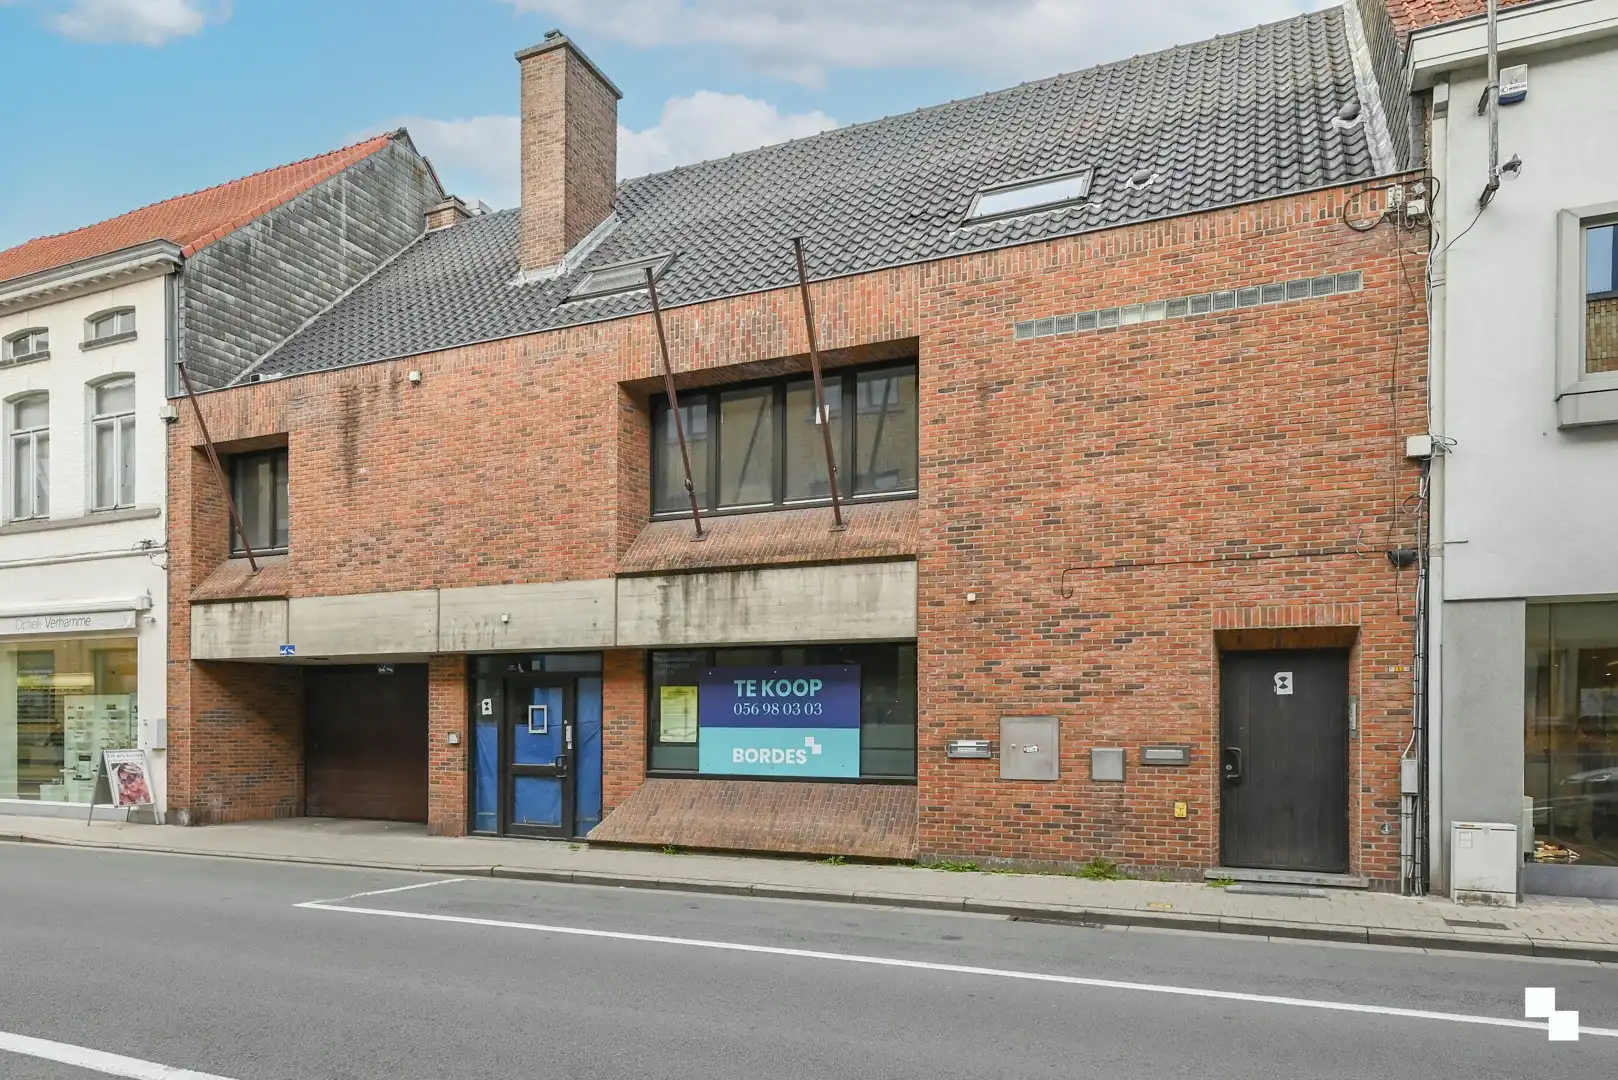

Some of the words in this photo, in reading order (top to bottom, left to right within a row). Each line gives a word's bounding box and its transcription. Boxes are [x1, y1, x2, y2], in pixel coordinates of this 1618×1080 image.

[45, 616, 92, 628] Verhamme
[733, 679, 757, 697] TE
[761, 678, 823, 697] KOOP
[733, 702, 759, 716] 056
[762, 702, 780, 716] 98
[782, 702, 801, 716] 03
[804, 702, 823, 716] 03
[732, 747, 808, 765] BORDES
